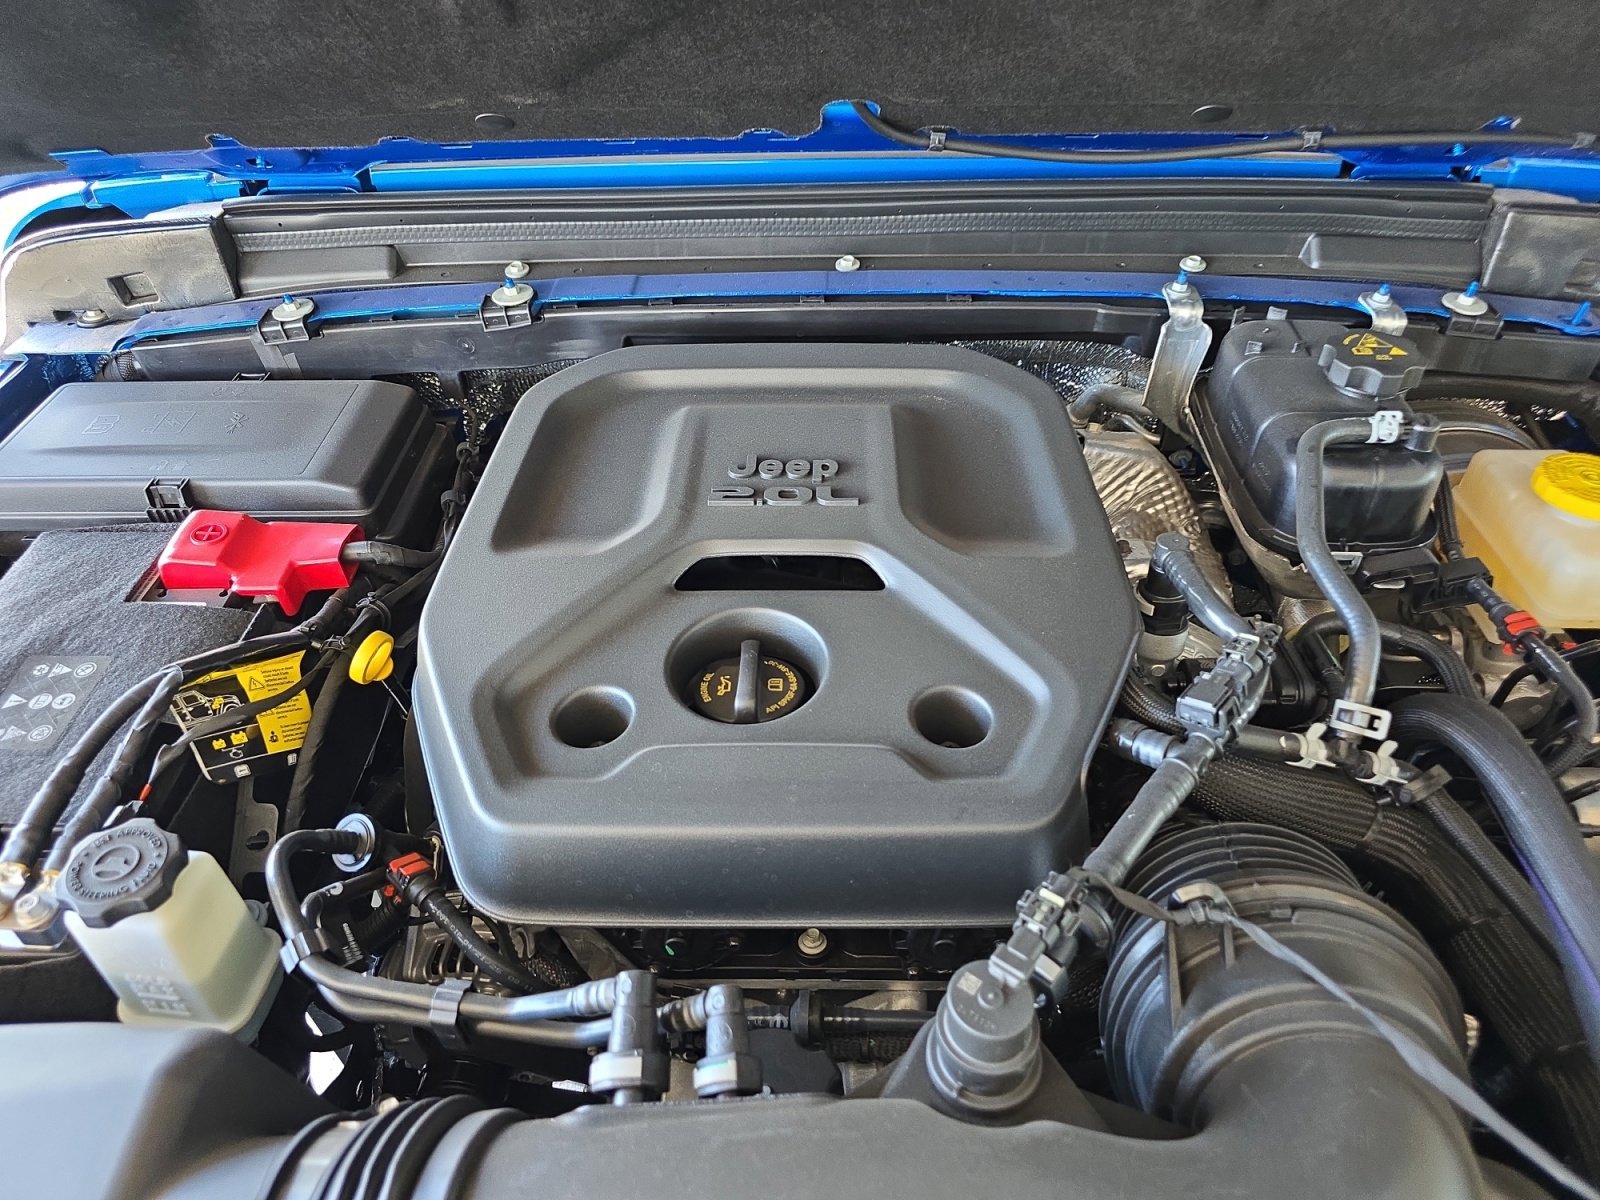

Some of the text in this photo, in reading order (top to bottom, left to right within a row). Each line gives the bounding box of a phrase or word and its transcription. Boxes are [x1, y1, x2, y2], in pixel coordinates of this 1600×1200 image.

[728, 454, 838, 484] Jeep
[708, 486, 859, 506] 2.0L
[700, 672, 715, 703] ENGINE OIL
[766, 703, 780, 714] API
